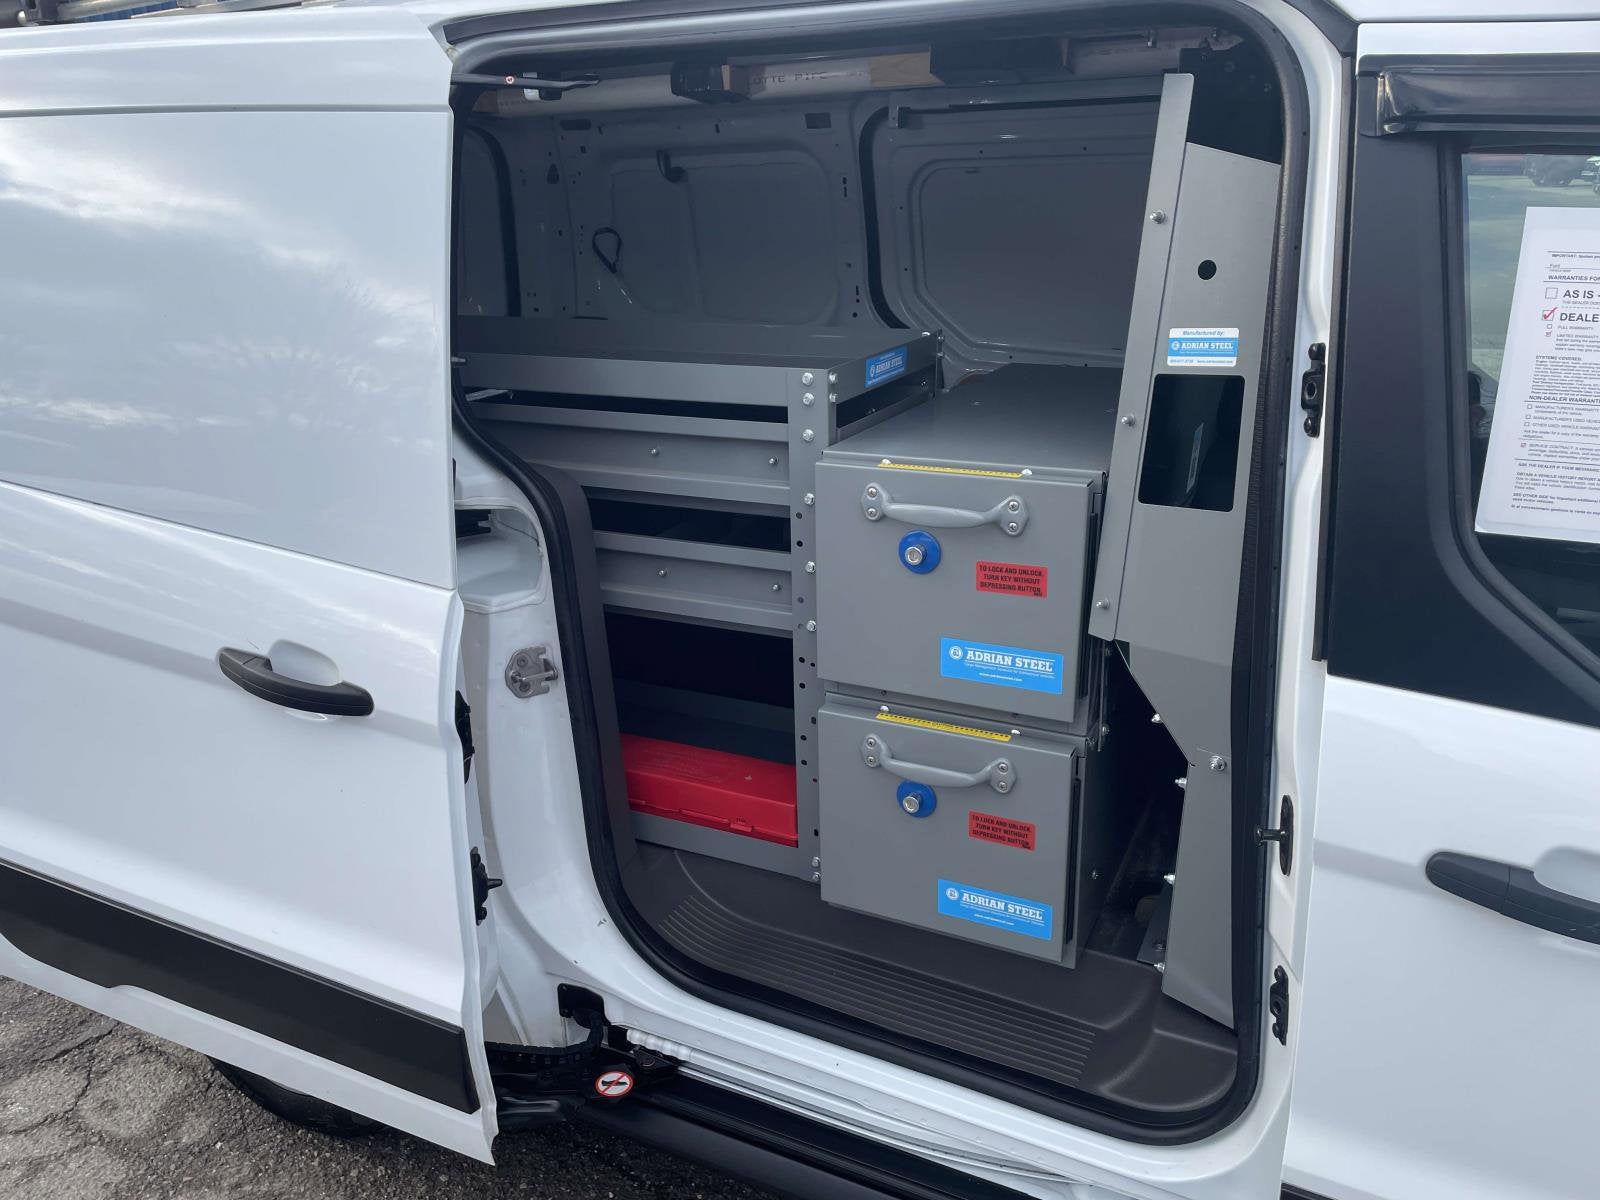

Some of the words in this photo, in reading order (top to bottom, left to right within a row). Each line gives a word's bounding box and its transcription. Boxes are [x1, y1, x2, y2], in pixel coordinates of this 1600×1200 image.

[1563, 289, 1580, 298] AS
[1583, 290, 1594, 299] IS
[1210, 342, 1234, 350] STEEL
[979, 564, 987, 572] TO
[988, 565, 1004, 573] LOCK
[984, 573, 1000, 581] TURN
[1012, 576, 1040, 585] WITHOUT
[980, 581, 1017, 591] DEPRESSING
[966, 650, 1012, 666] ADRIAN
[1015, 657, 1053, 672] STEEL
[972, 814, 980, 822] TO
[980, 816, 995, 825] LOCK
[995, 819, 1008, 828] AND
[972, 829, 1007, 842] DEPRESSING
[976, 823, 991, 831] TURN
[1003, 829, 1028, 839] WITHOUT
[962, 892, 1005, 911] ADRIAN
[1007, 903, 1043, 920] STEEL
